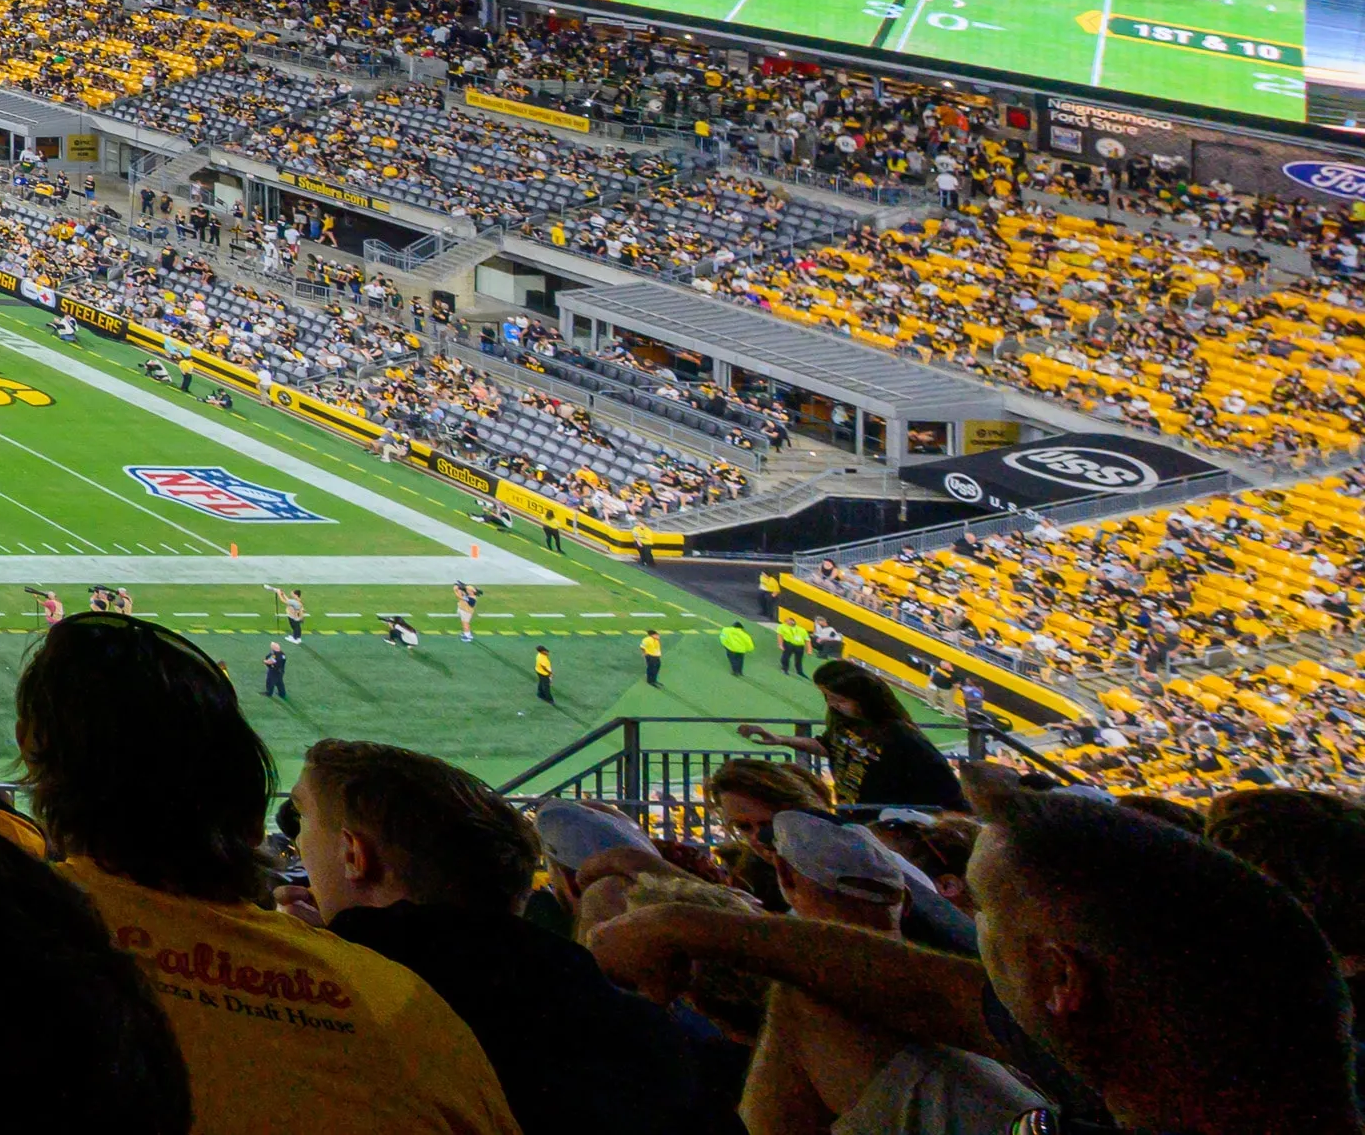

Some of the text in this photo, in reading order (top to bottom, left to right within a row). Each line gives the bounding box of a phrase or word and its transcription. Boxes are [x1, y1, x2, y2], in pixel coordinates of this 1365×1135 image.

[1133, 23, 1280, 61] 1ST & 10
[1050, 110, 1139, 135] Ford Store
[297, 177, 369, 208] Steelers.com
[60, 298, 122, 334] STEELERS
[436, 458, 490, 493] Steelers
[1027, 450, 1141, 486] USS
[144, 471, 251, 518] NFL
[950, 478, 976, 497] USS
[989, 495, 1004, 510] U.
[199, 990, 219, 1009] &
[222, 994, 282, 1020] Draft
[285, 1007, 357, 1034] House
